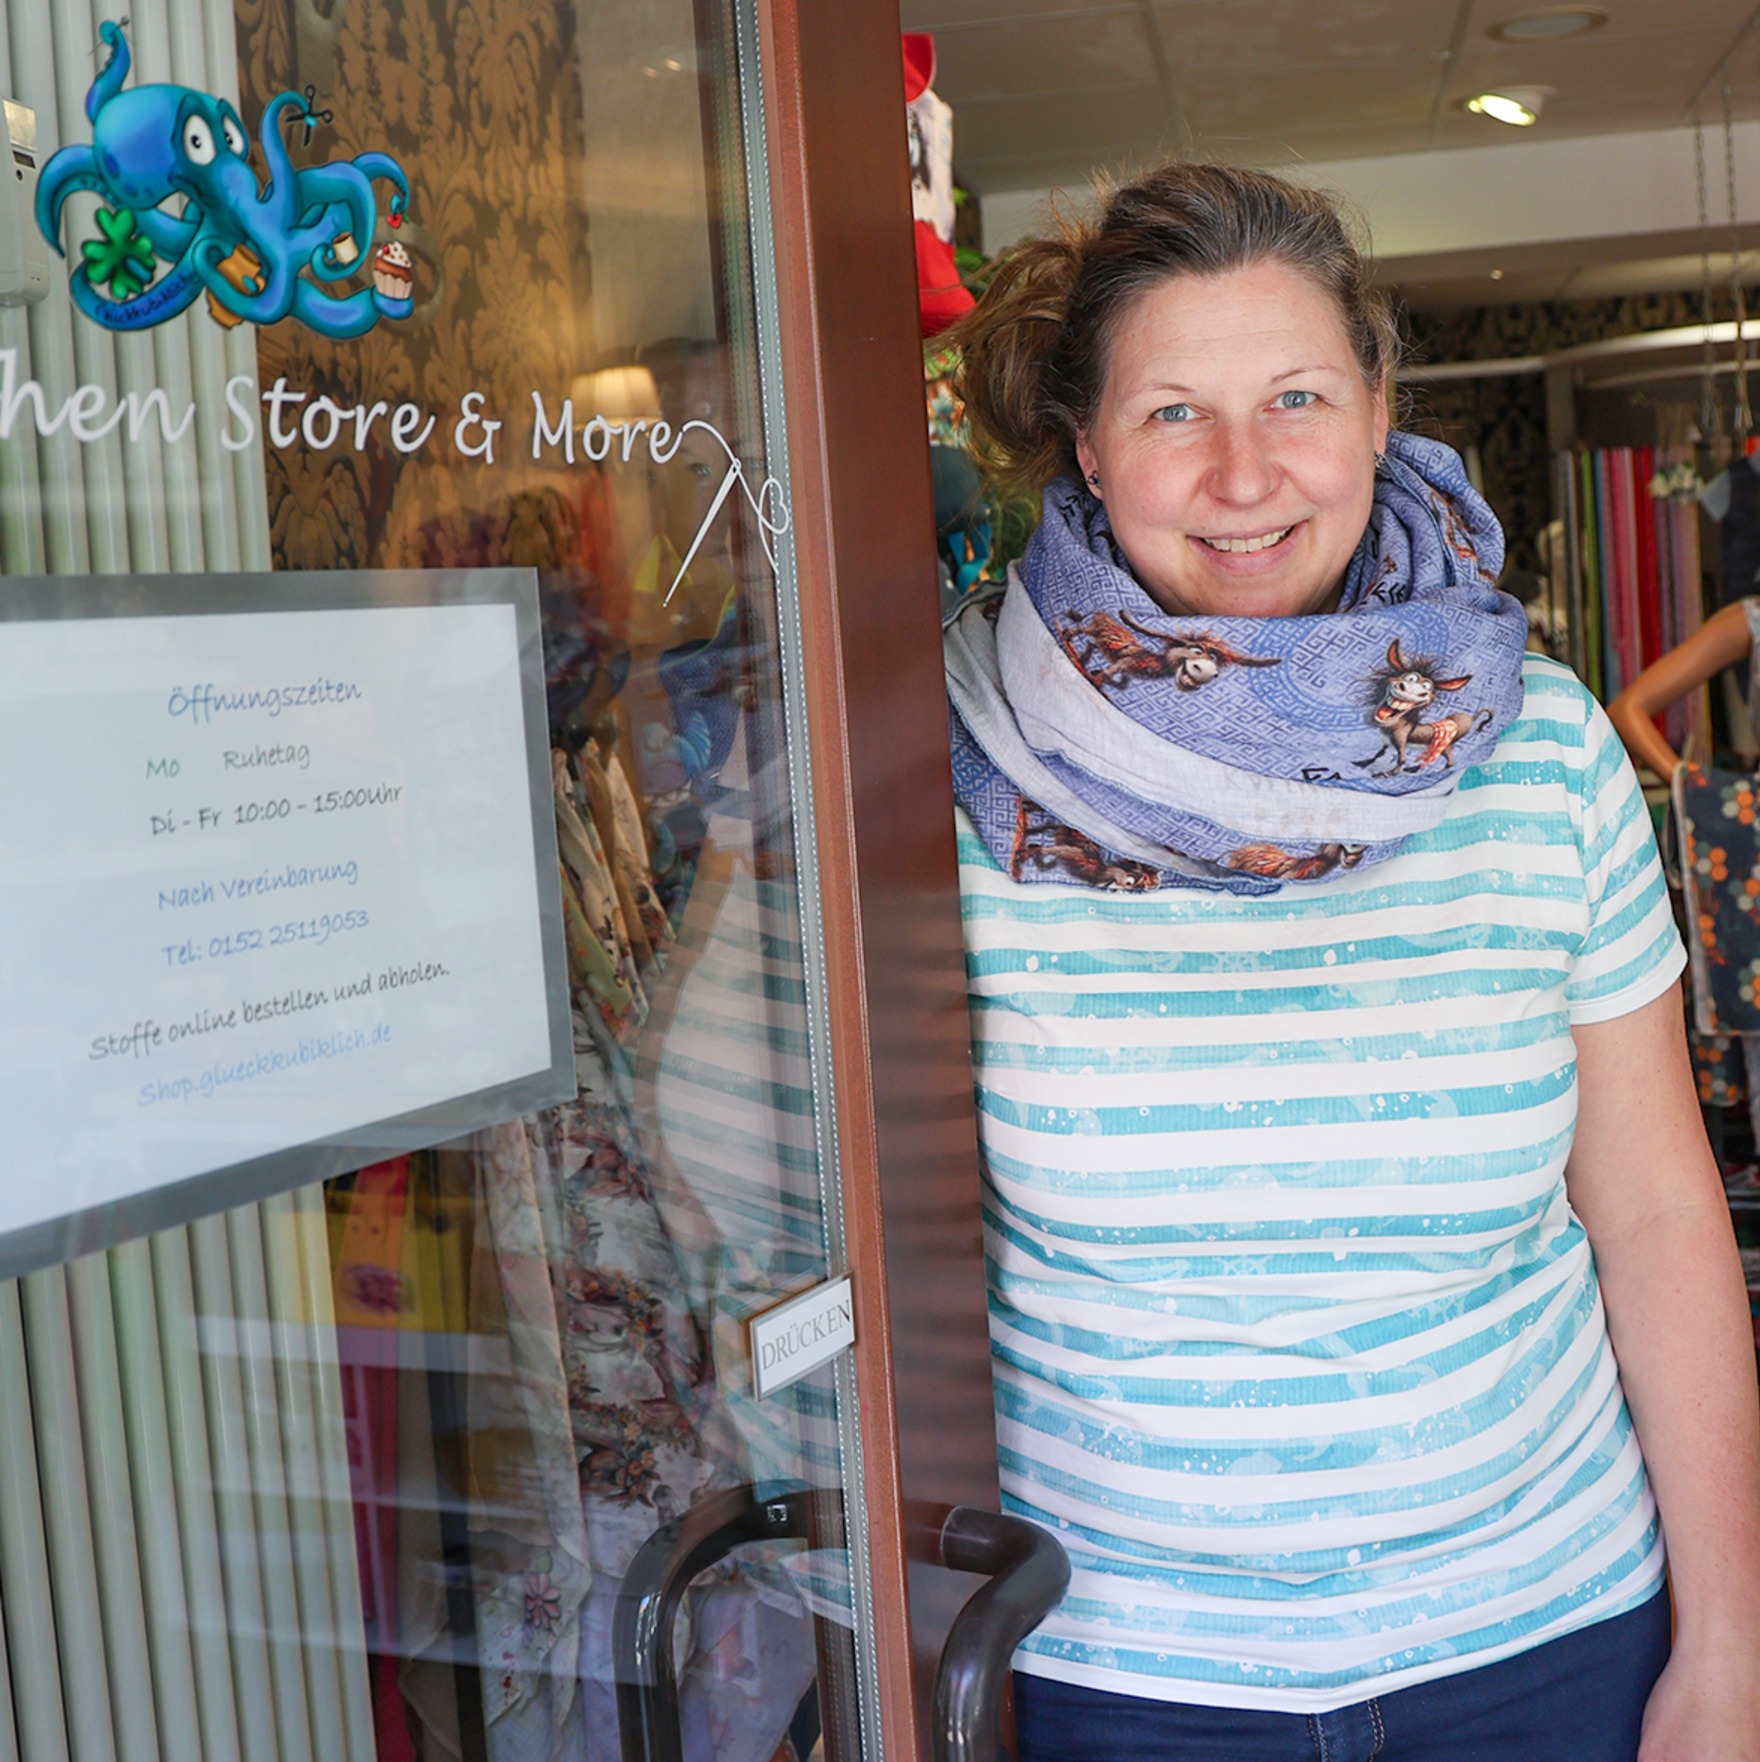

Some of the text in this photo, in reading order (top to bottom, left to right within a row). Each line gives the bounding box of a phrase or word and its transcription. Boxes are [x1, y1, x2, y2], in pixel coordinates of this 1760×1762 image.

[220, 374, 436, 453] Store
[454, 391, 502, 465] &
[531, 390, 684, 465] More
[168, 677, 362, 724] Öffnungszeiten
[145, 743, 311, 779] Mo Ruhetag
[150, 808, 176, 836] Di
[198, 805, 222, 830] Fr
[234, 797, 292, 825] 10:00
[157, 859, 359, 911] Nach Vereinbarung
[161, 909, 370, 967] Tel: 0152 25119053
[88, 960, 451, 1061] Stoffe online bestellen und abholen.
[760, 1299, 851, 1371] DRÜCKEN
